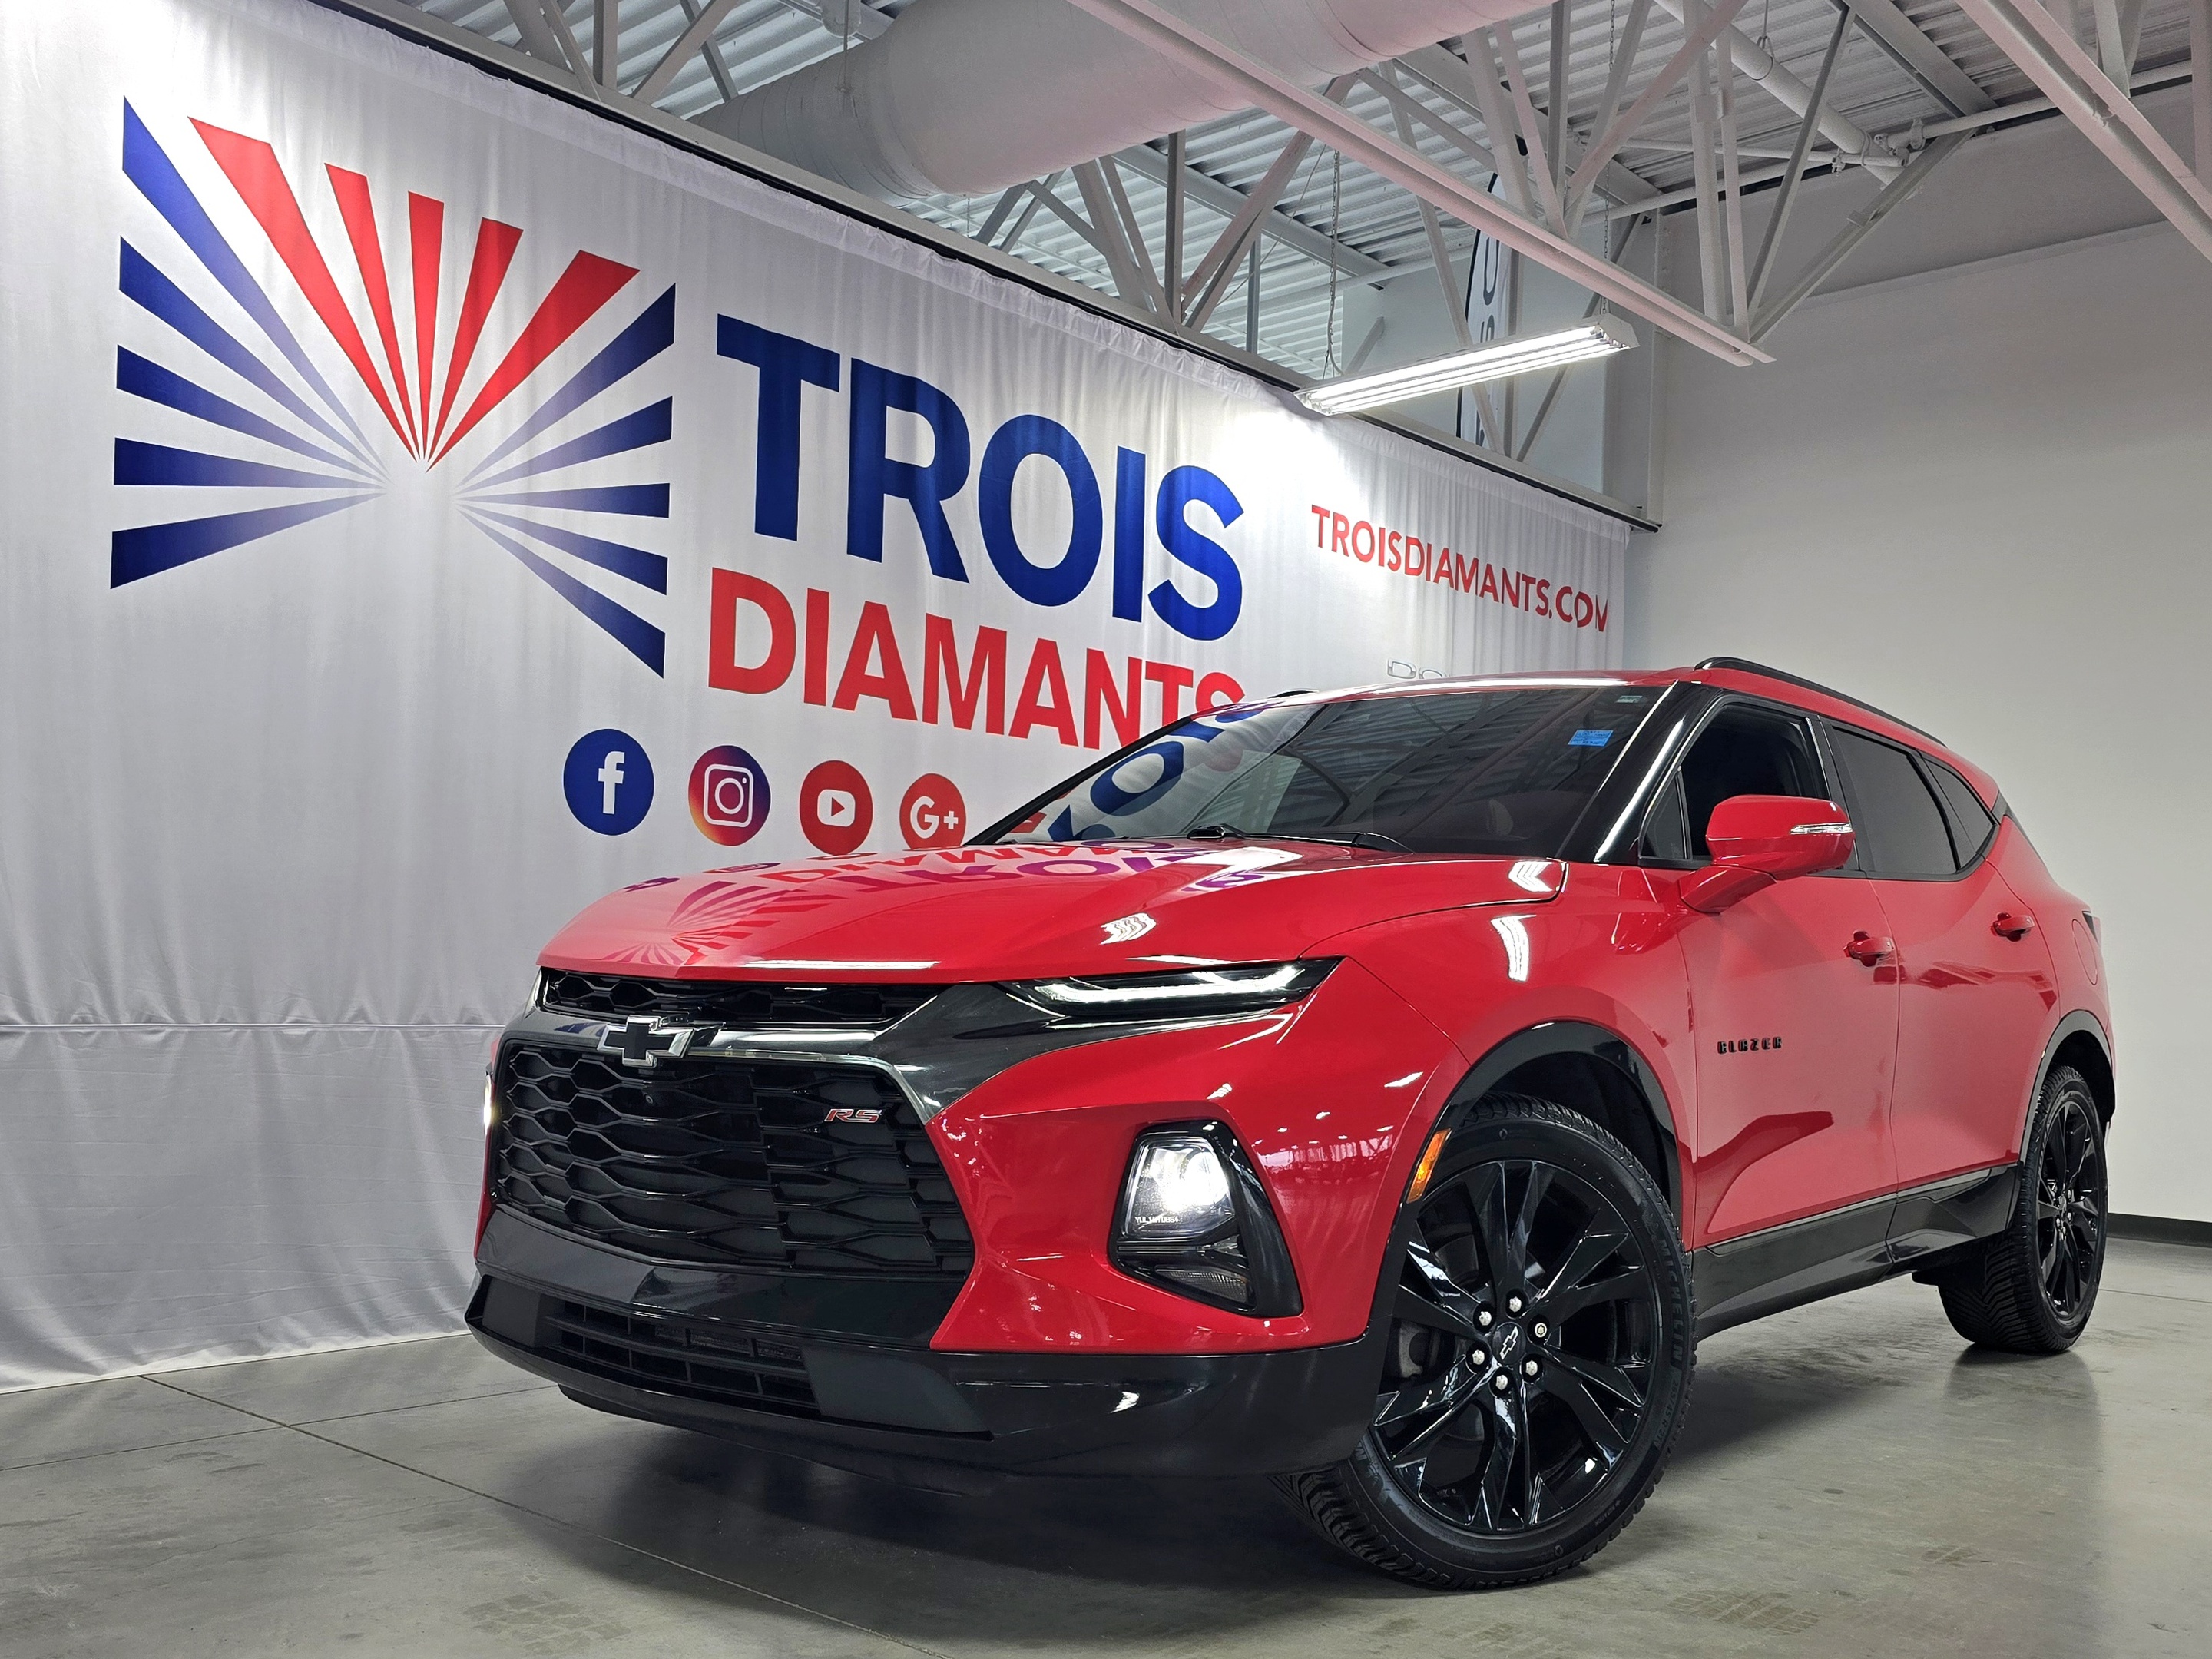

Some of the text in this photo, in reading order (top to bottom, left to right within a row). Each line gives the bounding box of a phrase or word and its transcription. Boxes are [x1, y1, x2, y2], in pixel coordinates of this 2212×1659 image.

[716, 313, 1244, 641] TROIS
[1311, 505, 1608, 632] TROISDIAMANTS.COM
[1717, 1037, 1782, 1054] BLAZER
[824, 1108, 882, 1123] RS
[1660, 1238, 1684, 1362] MICHELIN
